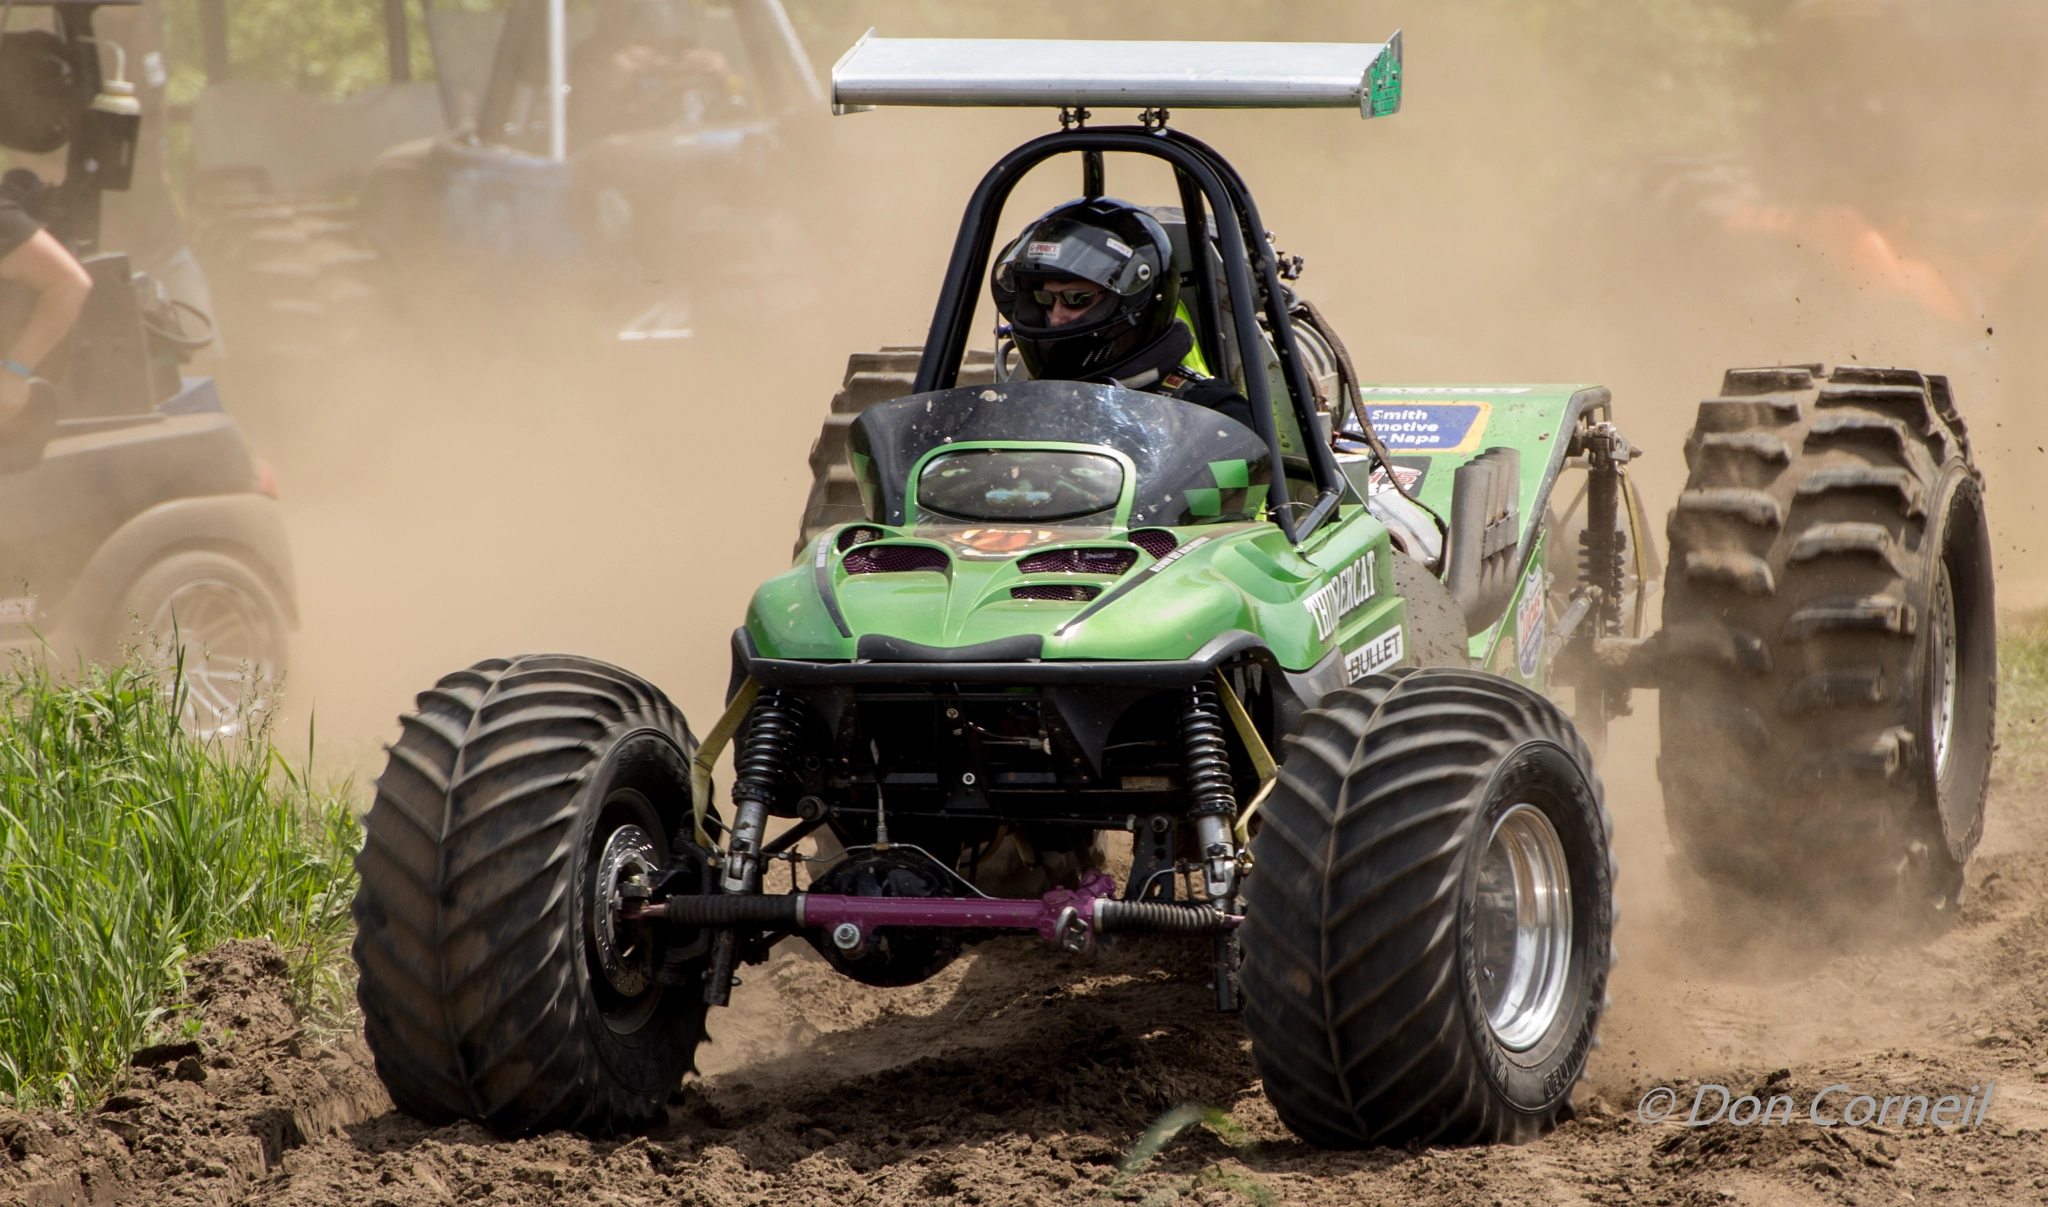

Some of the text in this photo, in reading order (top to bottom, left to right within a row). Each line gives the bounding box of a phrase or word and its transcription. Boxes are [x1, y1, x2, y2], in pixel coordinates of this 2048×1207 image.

[1371, 409, 1428, 420] Smith
[1389, 433, 1441, 445] Napa
[1349, 631, 1401, 682] BULLET
